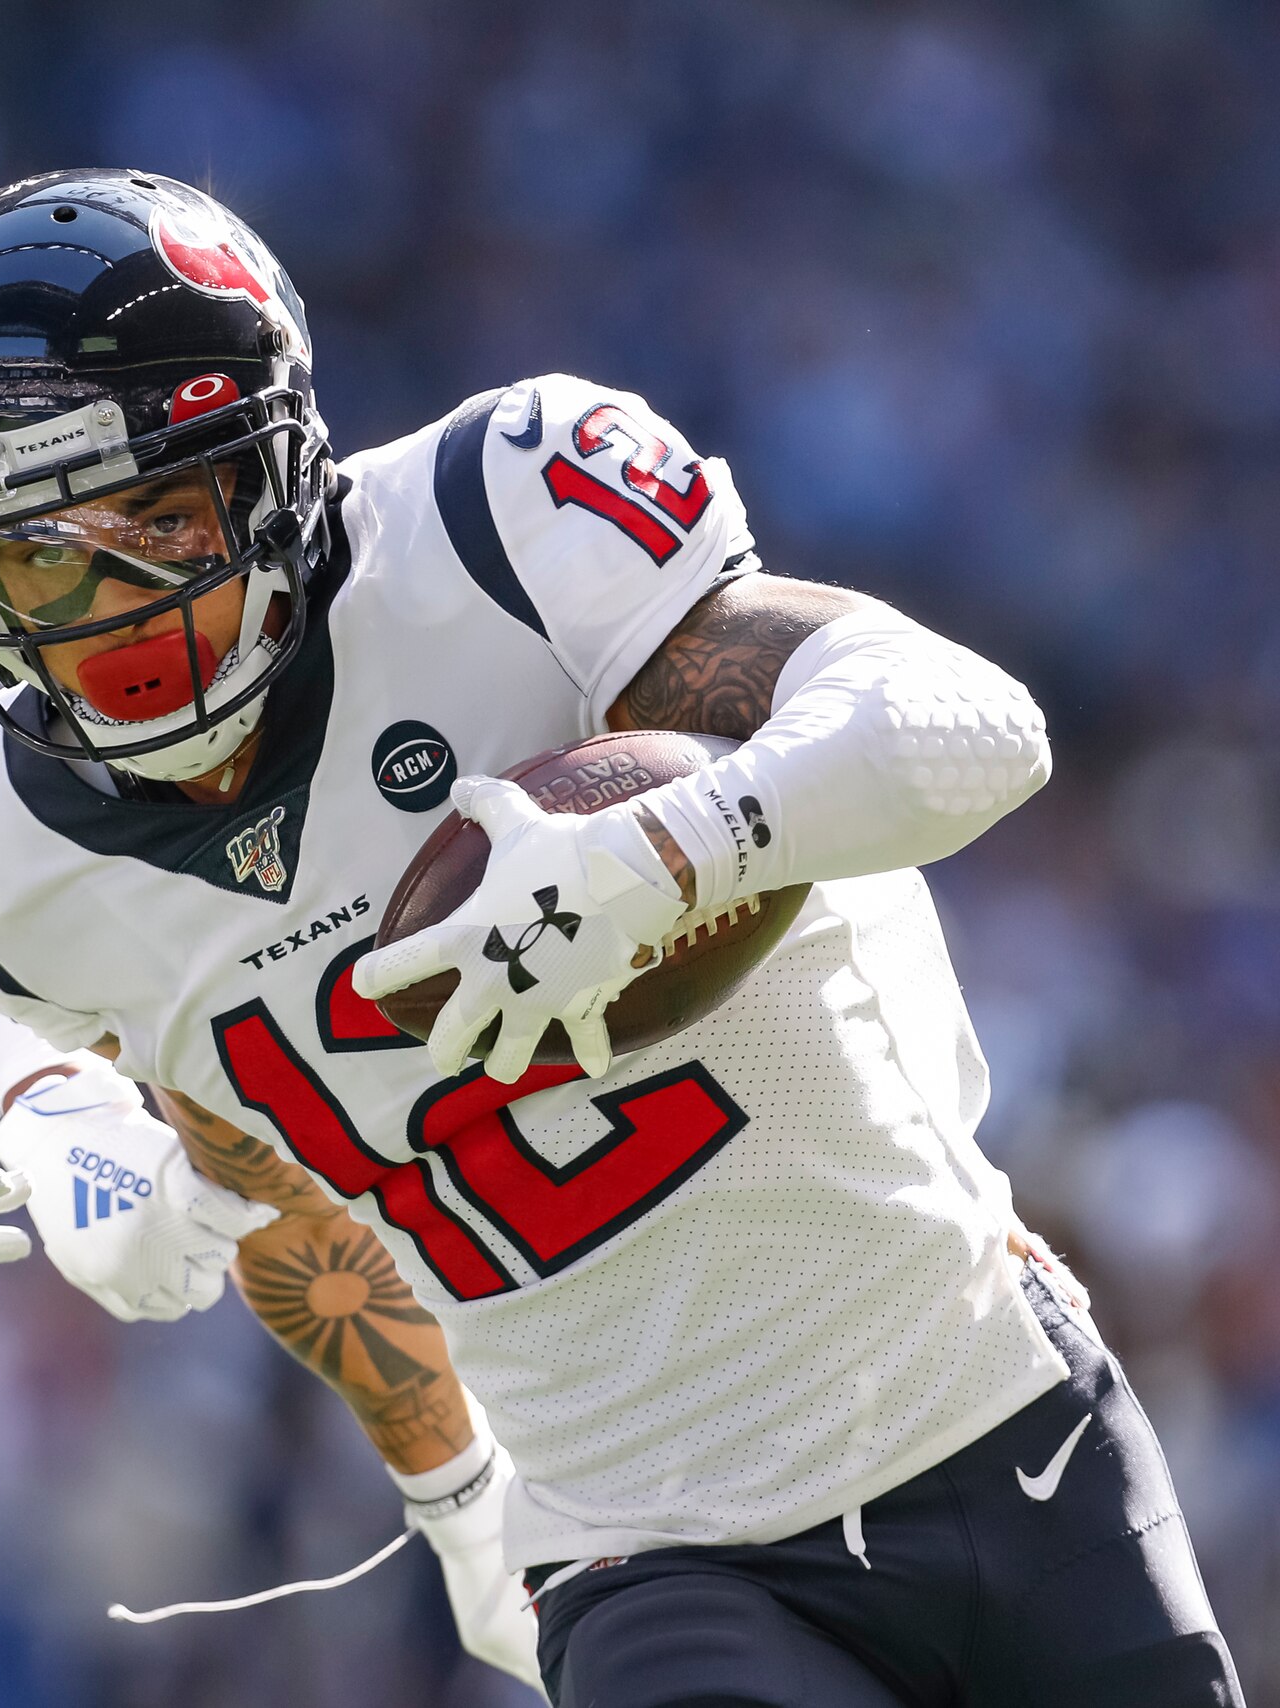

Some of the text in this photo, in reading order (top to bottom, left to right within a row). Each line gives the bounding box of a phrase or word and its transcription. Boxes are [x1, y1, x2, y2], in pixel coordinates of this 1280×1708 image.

[15, 428, 86, 455] TEXANS
[541, 402, 715, 569] 12
[391, 749, 434, 783] RCM
[529, 752, 638, 809] CATCH
[260, 863, 283, 885] NFL
[238, 893, 371, 970] TEXANS
[210, 932, 751, 1302] 12
[67, 1146, 153, 1198] adidas
